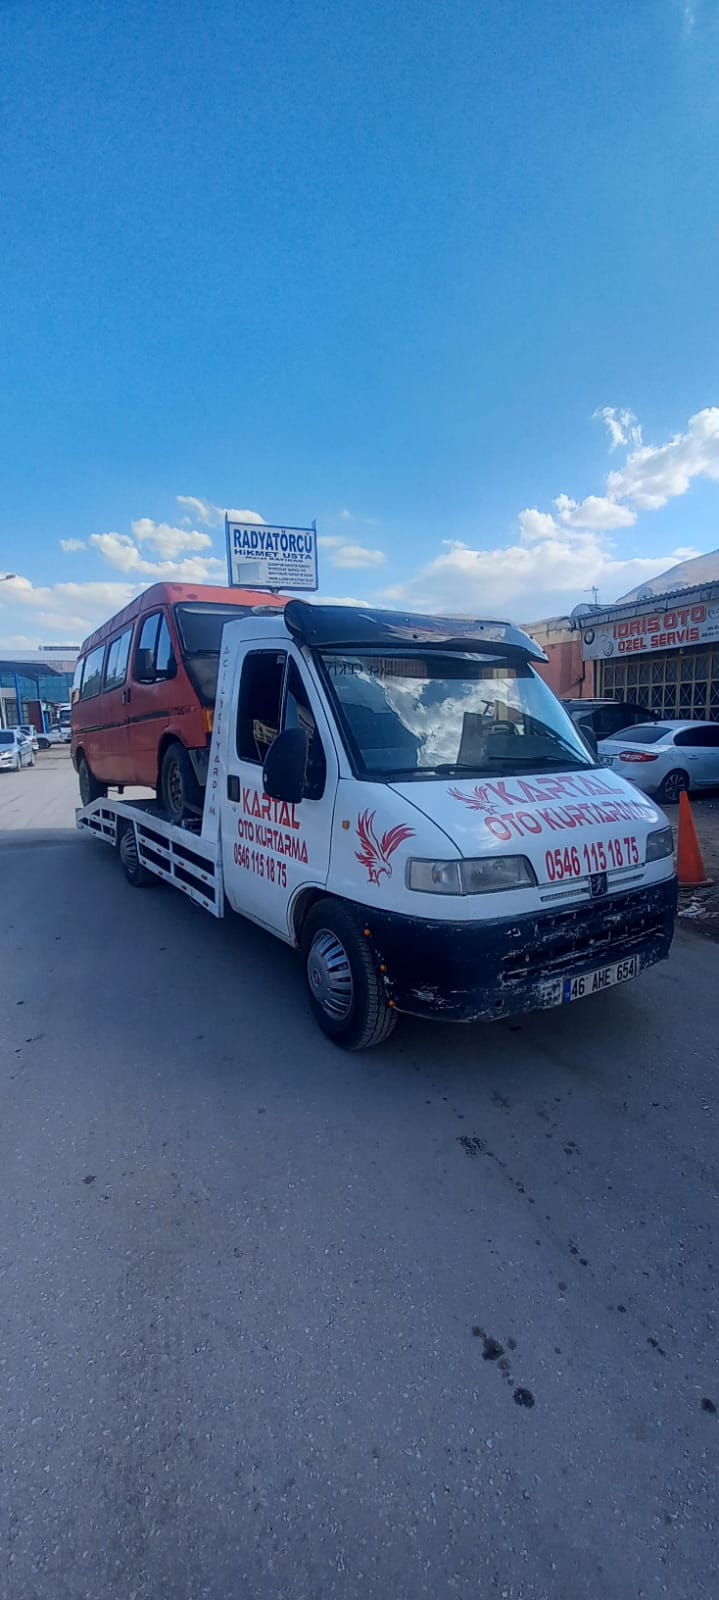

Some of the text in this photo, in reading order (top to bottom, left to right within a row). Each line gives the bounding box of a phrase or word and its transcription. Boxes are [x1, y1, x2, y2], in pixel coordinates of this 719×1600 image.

[233, 529, 312, 553] RADYATÖRCÜ
[283, 552, 312, 560] USTA
[664, 605, 707, 631] OTO
[242, 787, 301, 830] KARTAL
[485, 775, 624, 805] KARTAL
[484, 799, 653, 840] OTO KURTARMA
[238, 818, 308, 864] OTO KURTARMA
[545, 836, 639, 881] 0546 115 18 75
[233, 842, 287, 888] 0546 115 18 75
[572, 960, 634, 997] 46 AHE 654
